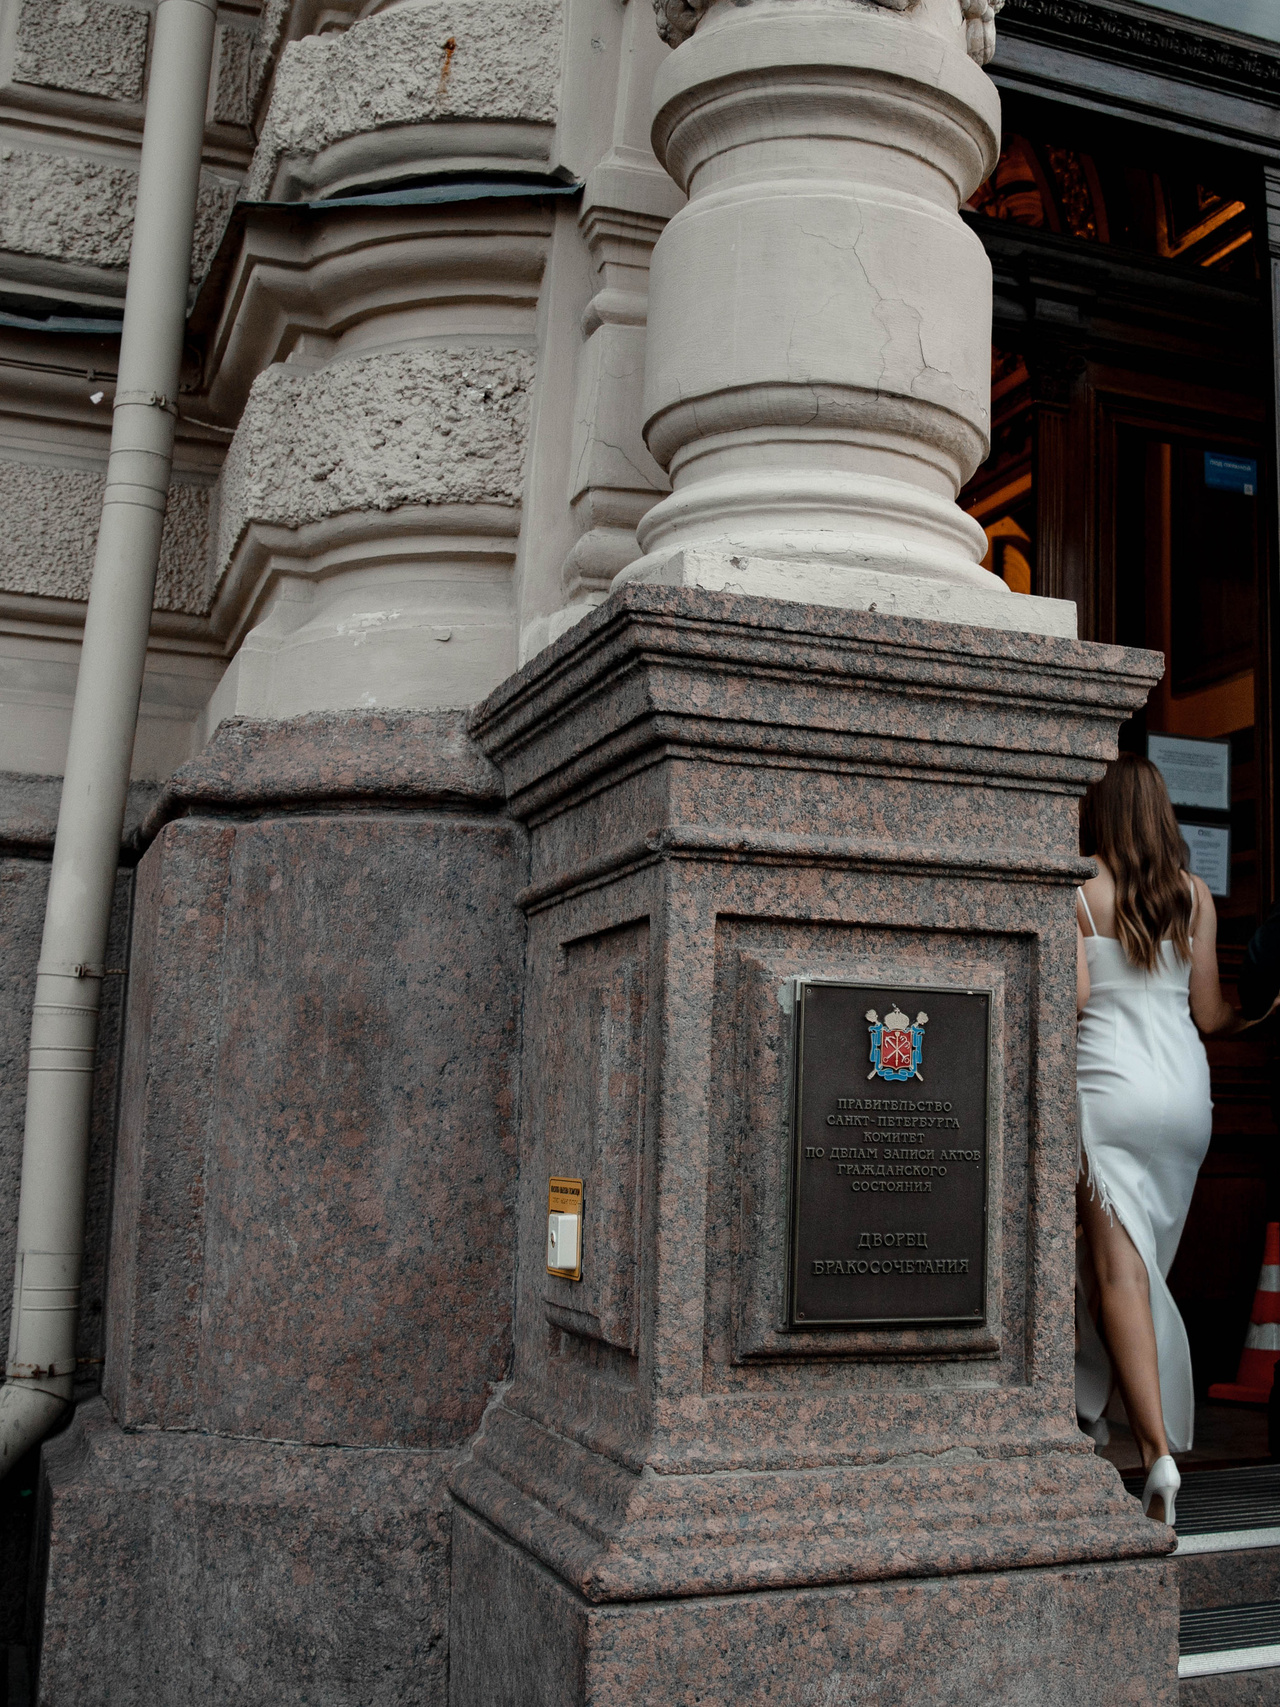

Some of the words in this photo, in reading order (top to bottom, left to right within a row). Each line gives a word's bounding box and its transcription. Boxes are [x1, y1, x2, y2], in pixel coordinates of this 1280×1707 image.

[836, 1098, 953, 1112] ПРАВИТЕЛЬСТВО
[826, 1114, 961, 1129] САНКТ-ПЕТЕРБУРГА
[862, 1131, 926, 1144] КОМИТЕТ
[805, 1146, 825, 1160] ПО
[828, 1147, 878, 1161] ДЕЛАМ
[882, 1148, 935, 1161] ЗАПИСИ
[939, 1149, 982, 1162] АКТОВ
[836, 1163, 948, 1177] ГРАЖДАНСКОГО
[851, 1180, 933, 1193] СОСТОЯНИЯ
[857, 1232, 929, 1250] ДВОРЕЦ
[812, 1259, 970, 1276] БРАКОСОЧЕТАНИЯ
